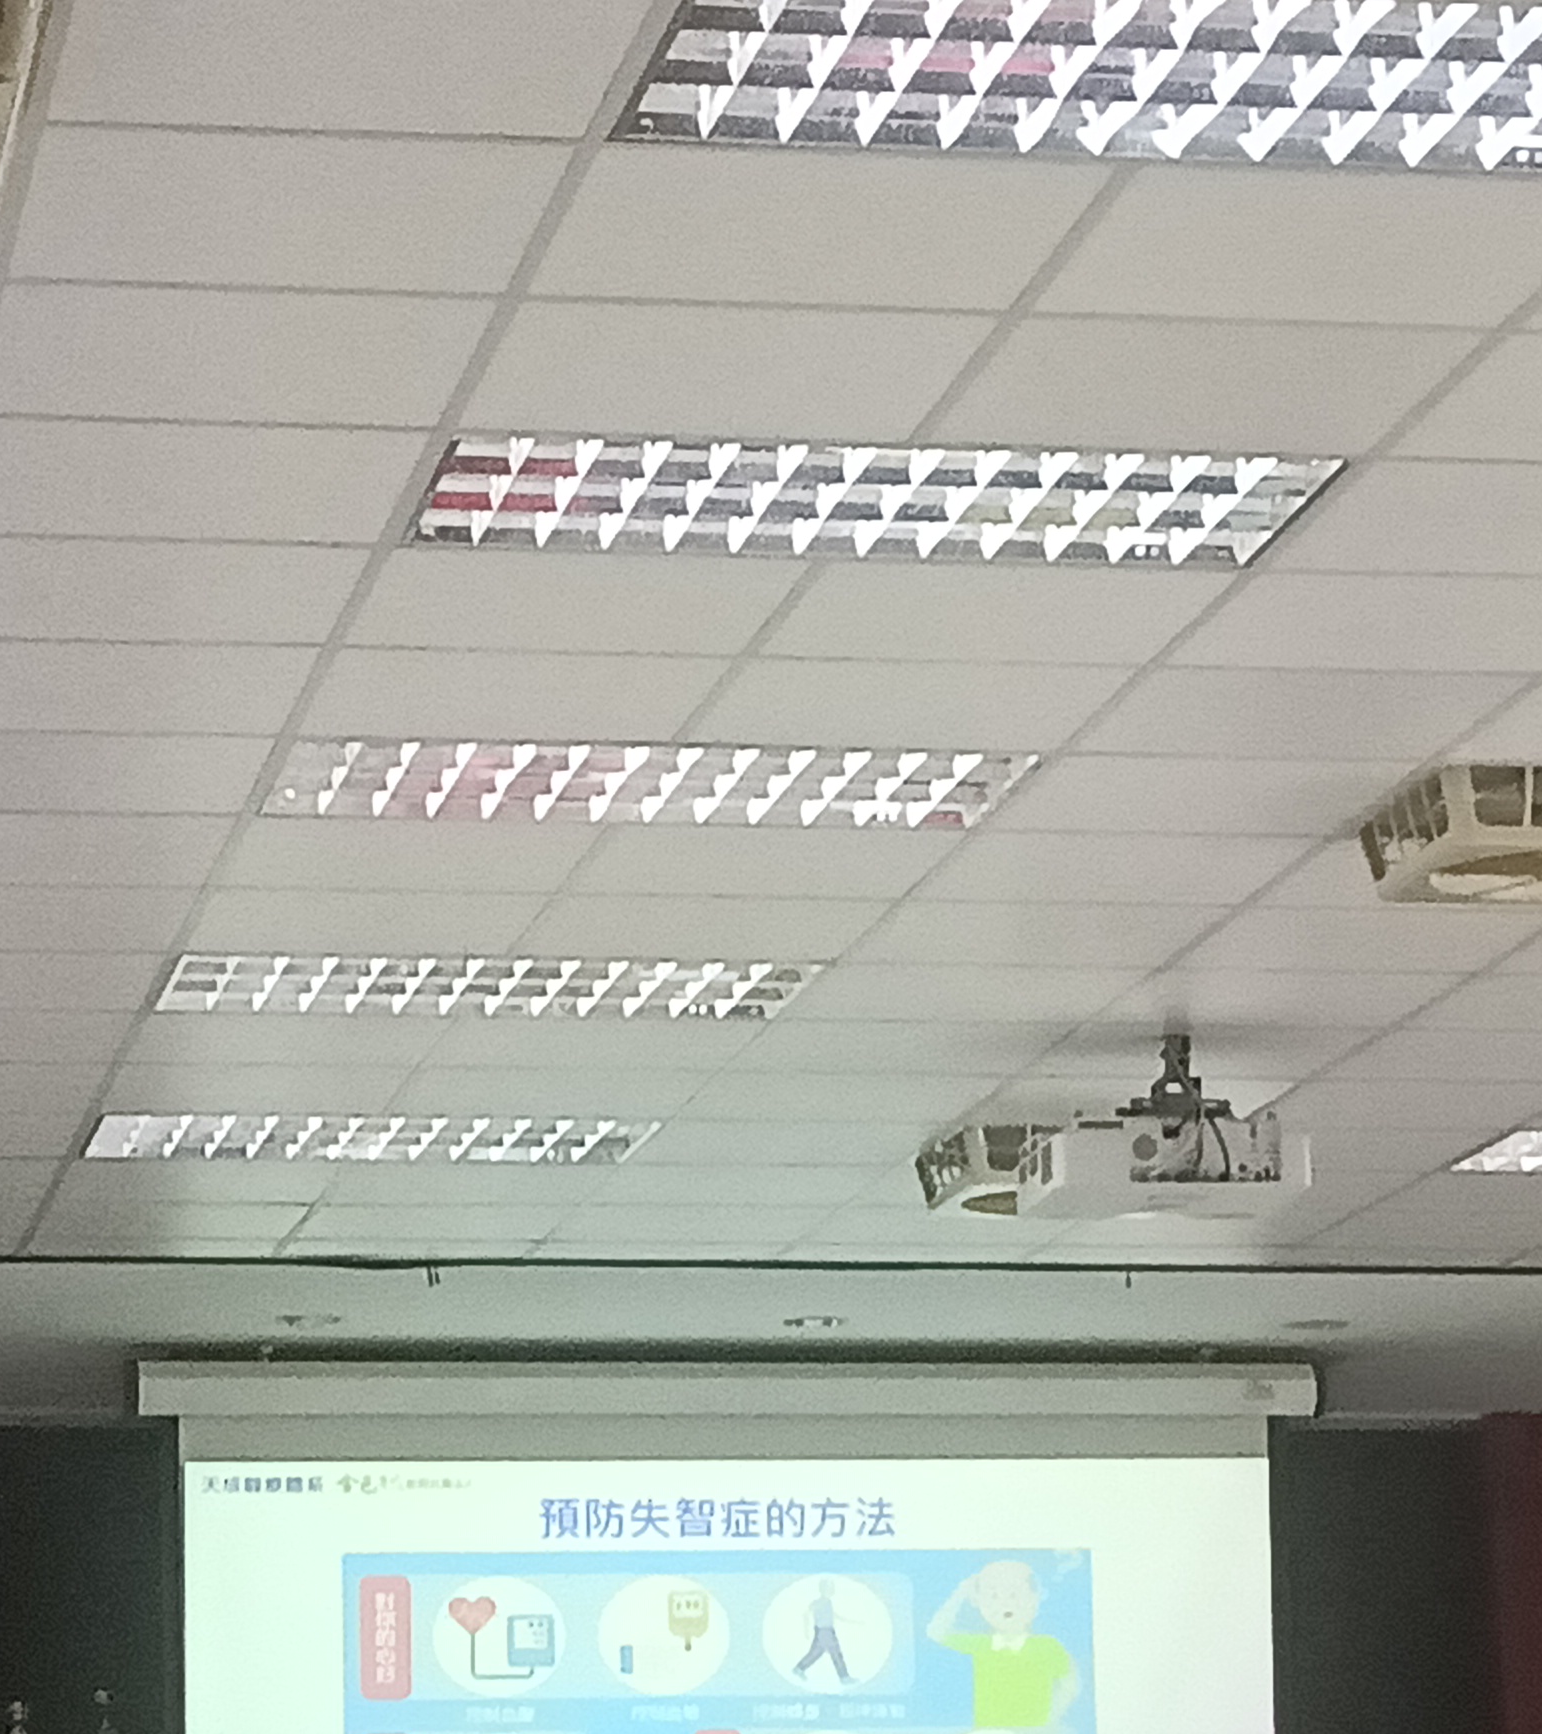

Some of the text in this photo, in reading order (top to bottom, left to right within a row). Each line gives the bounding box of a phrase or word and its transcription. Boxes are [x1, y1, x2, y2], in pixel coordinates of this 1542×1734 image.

[540, 1497, 896, 1539] 預防失智症的方法
